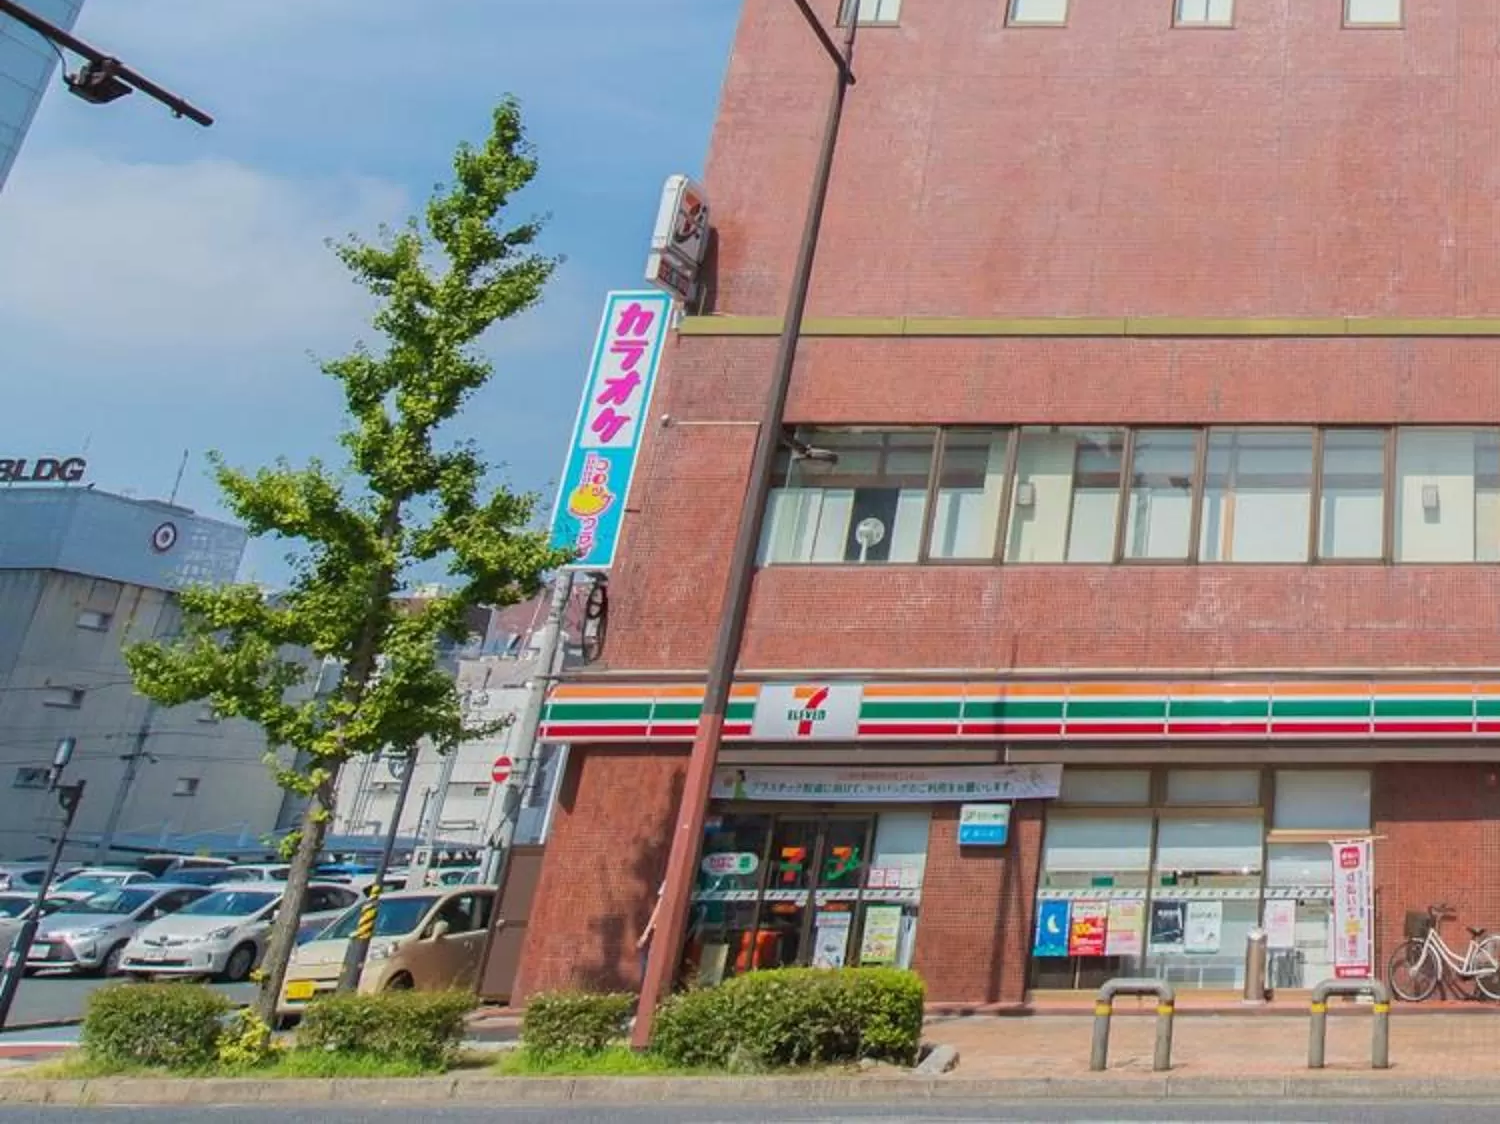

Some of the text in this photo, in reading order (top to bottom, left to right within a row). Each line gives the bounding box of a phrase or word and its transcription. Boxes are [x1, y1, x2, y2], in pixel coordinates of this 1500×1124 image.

[591, 302, 655, 443] カラオケ
[793, 687, 829, 735] 7
